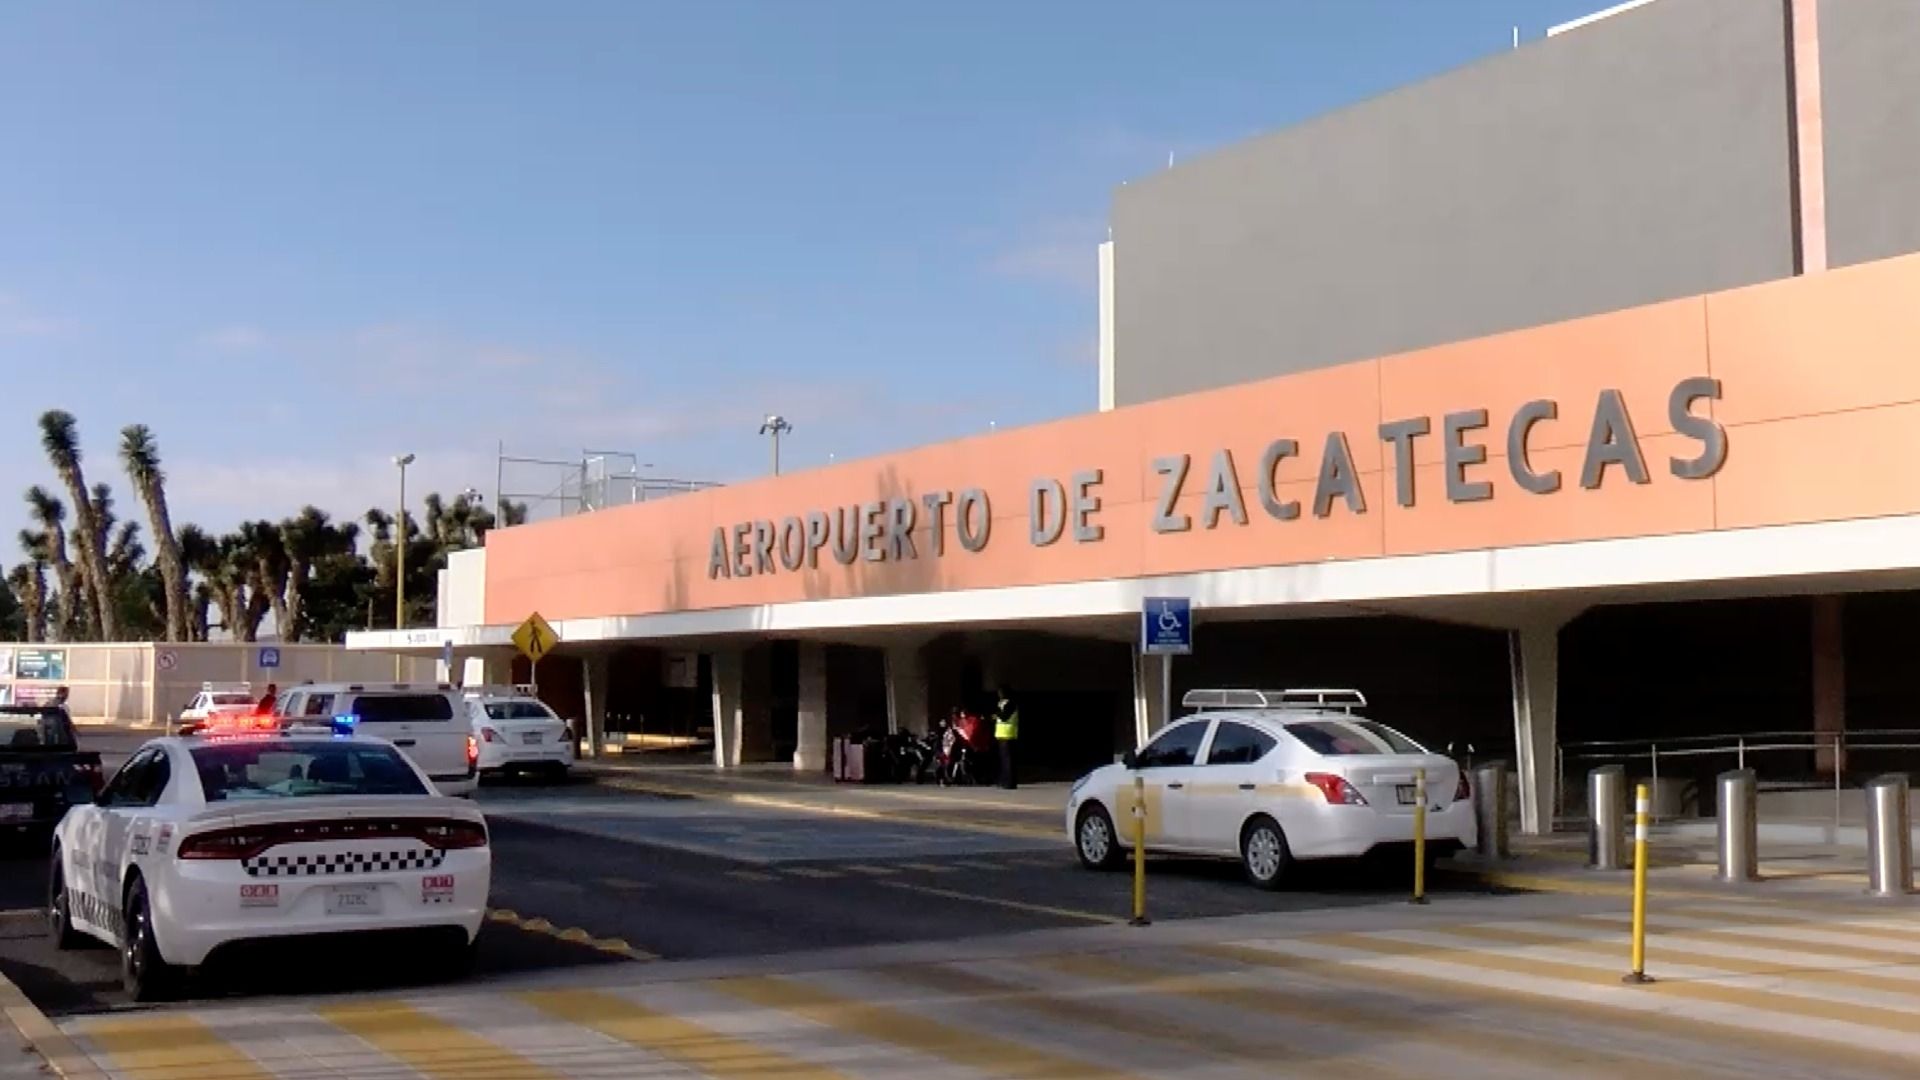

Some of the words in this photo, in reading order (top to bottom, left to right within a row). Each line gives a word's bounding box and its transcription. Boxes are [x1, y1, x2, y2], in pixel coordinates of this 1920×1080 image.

[708, 488, 992, 580] AEROPUERTO
[1029, 469, 1104, 547] DE
[1152, 377, 1728, 533] ZACATECAS
